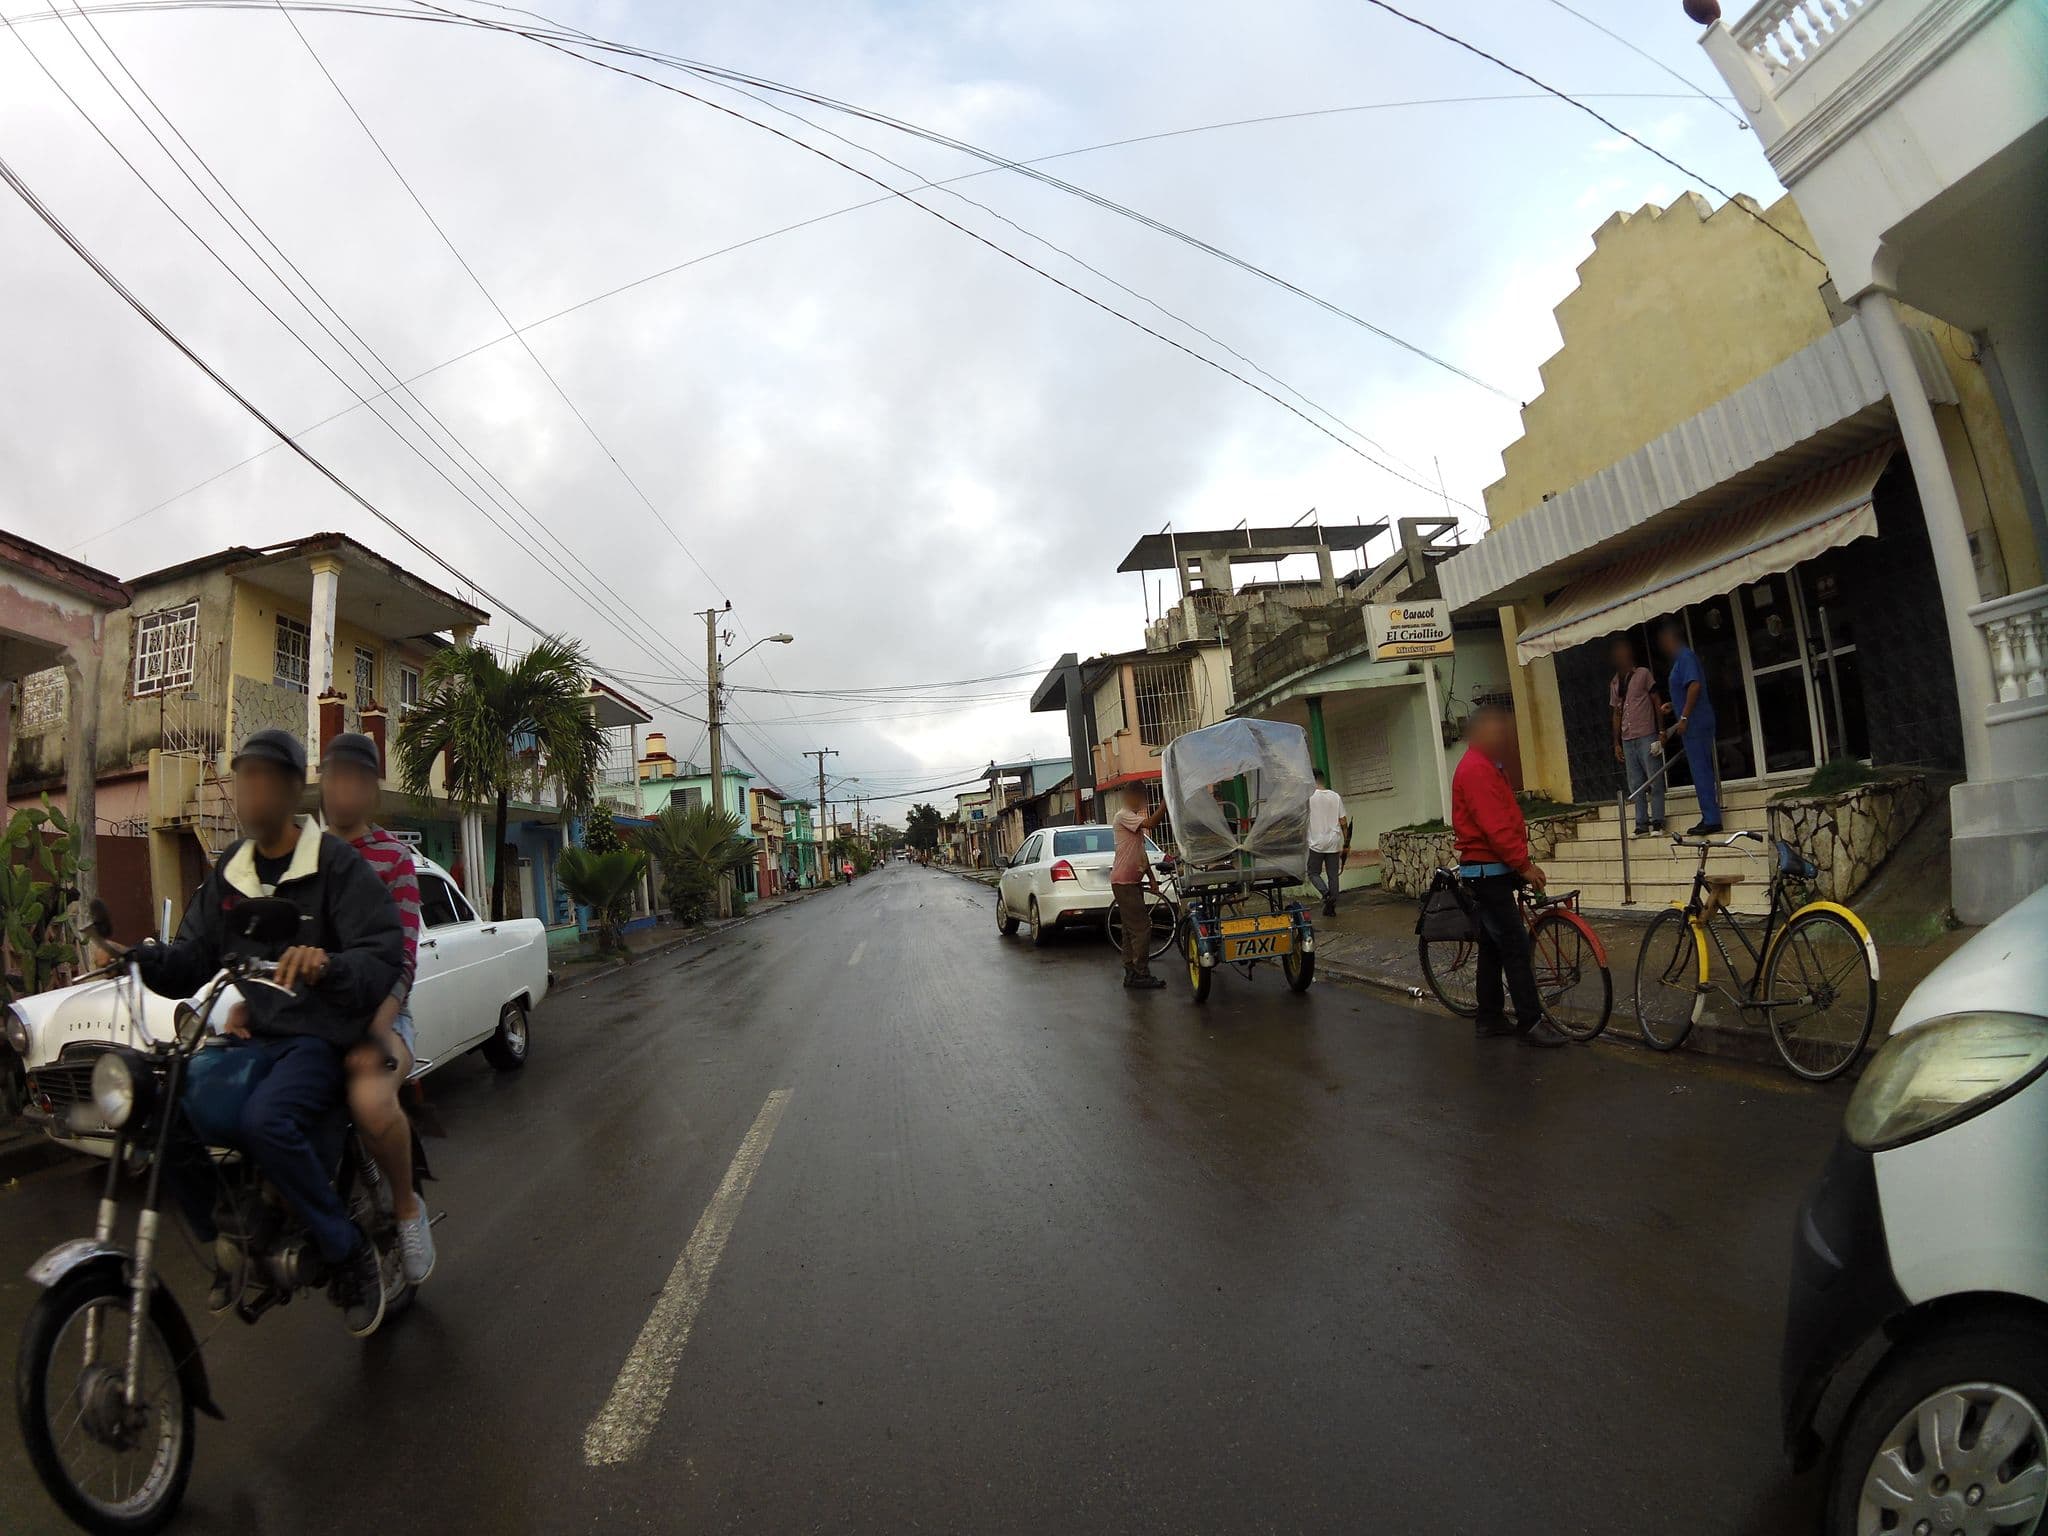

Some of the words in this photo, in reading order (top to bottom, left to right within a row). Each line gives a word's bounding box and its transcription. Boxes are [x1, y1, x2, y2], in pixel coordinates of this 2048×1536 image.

[1403, 608, 1435, 620] Caracol
[1386, 631, 1397, 641] El
[1400, 629, 1443, 640] Criollito
[1236, 937, 1277, 956] TAXI
